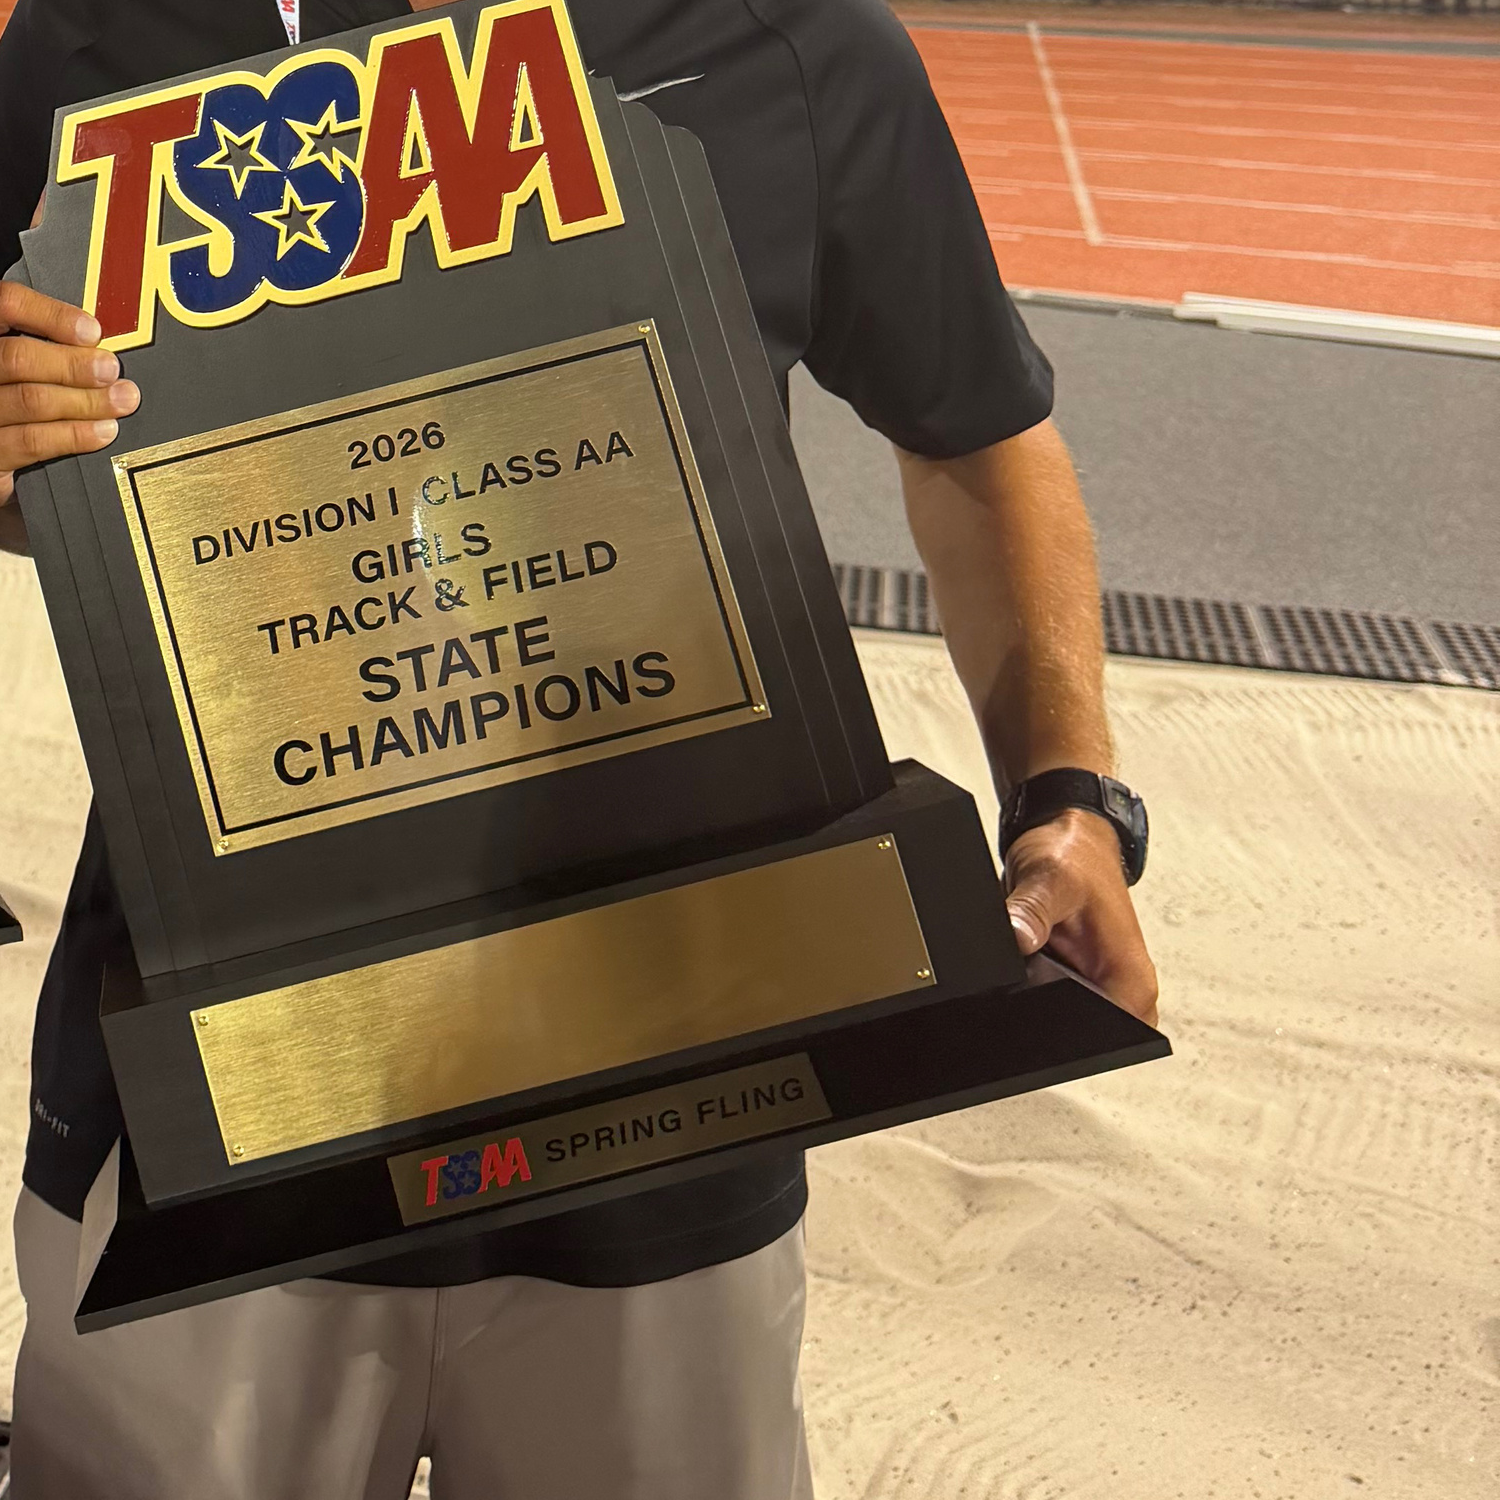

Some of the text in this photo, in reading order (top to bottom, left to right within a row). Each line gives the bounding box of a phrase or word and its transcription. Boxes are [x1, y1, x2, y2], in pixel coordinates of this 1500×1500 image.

[347, 421, 447, 470] 2026
[191, 431, 634, 566] DIVISION I CLASS AA
[257, 540, 618, 655] TRACK & FIELD
[351, 523, 492, 584] GIRLS
[358, 615, 556, 703] STATE
[273, 651, 676, 786] CHAMPIONS
[544, 1109, 682, 1163] SPRING
[697, 1077, 805, 1126] FLING
